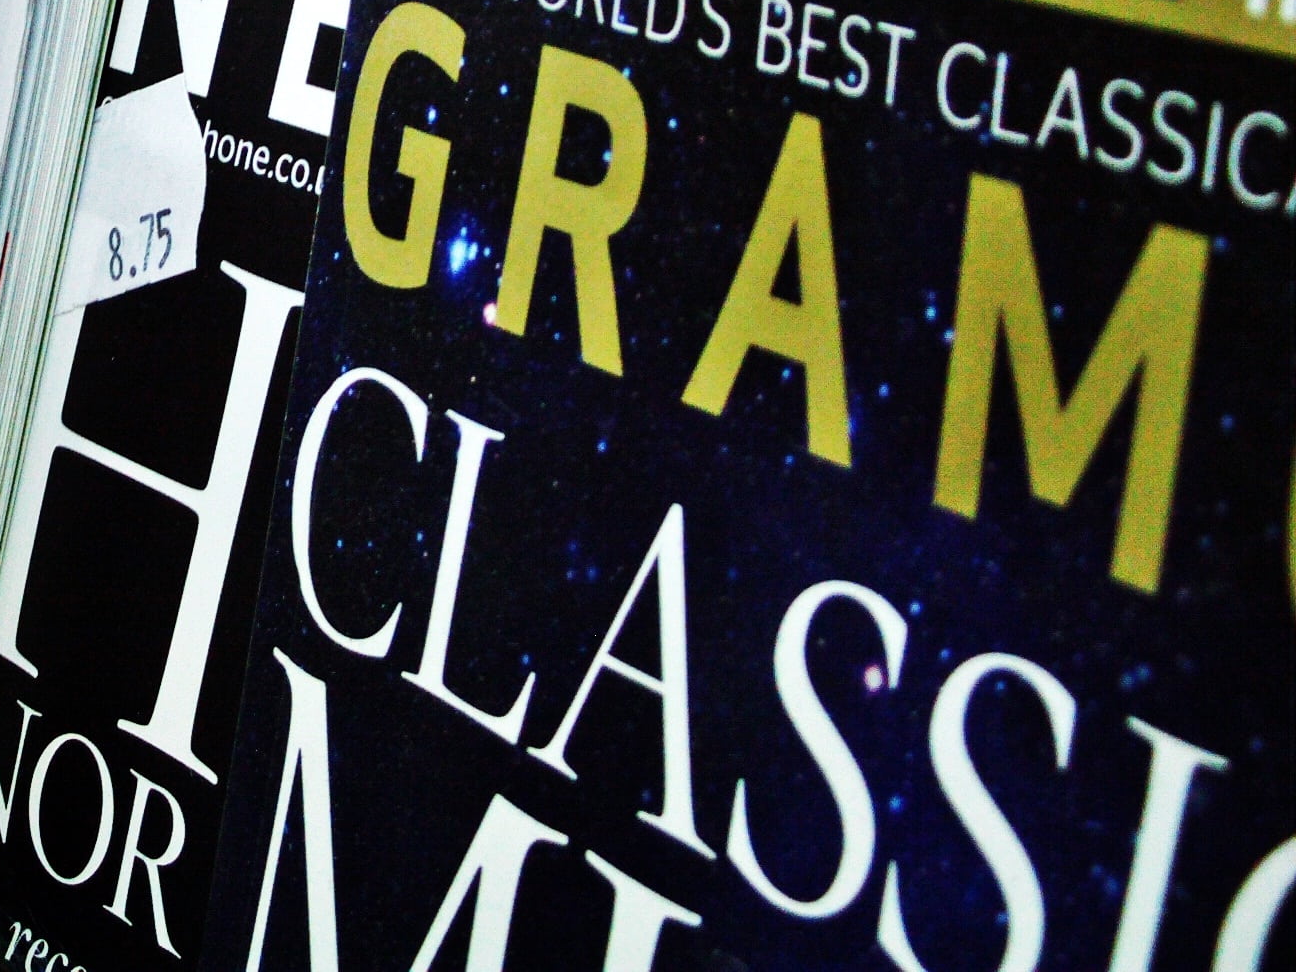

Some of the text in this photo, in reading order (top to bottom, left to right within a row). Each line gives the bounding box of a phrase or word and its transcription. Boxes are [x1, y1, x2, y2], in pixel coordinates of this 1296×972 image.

[935, 41, 1296, 212] CLASSIC
[108, 207, 173, 282] 8.75
[342, 1, 1212, 595] GRAM
[4, 920, 88, 972] re
